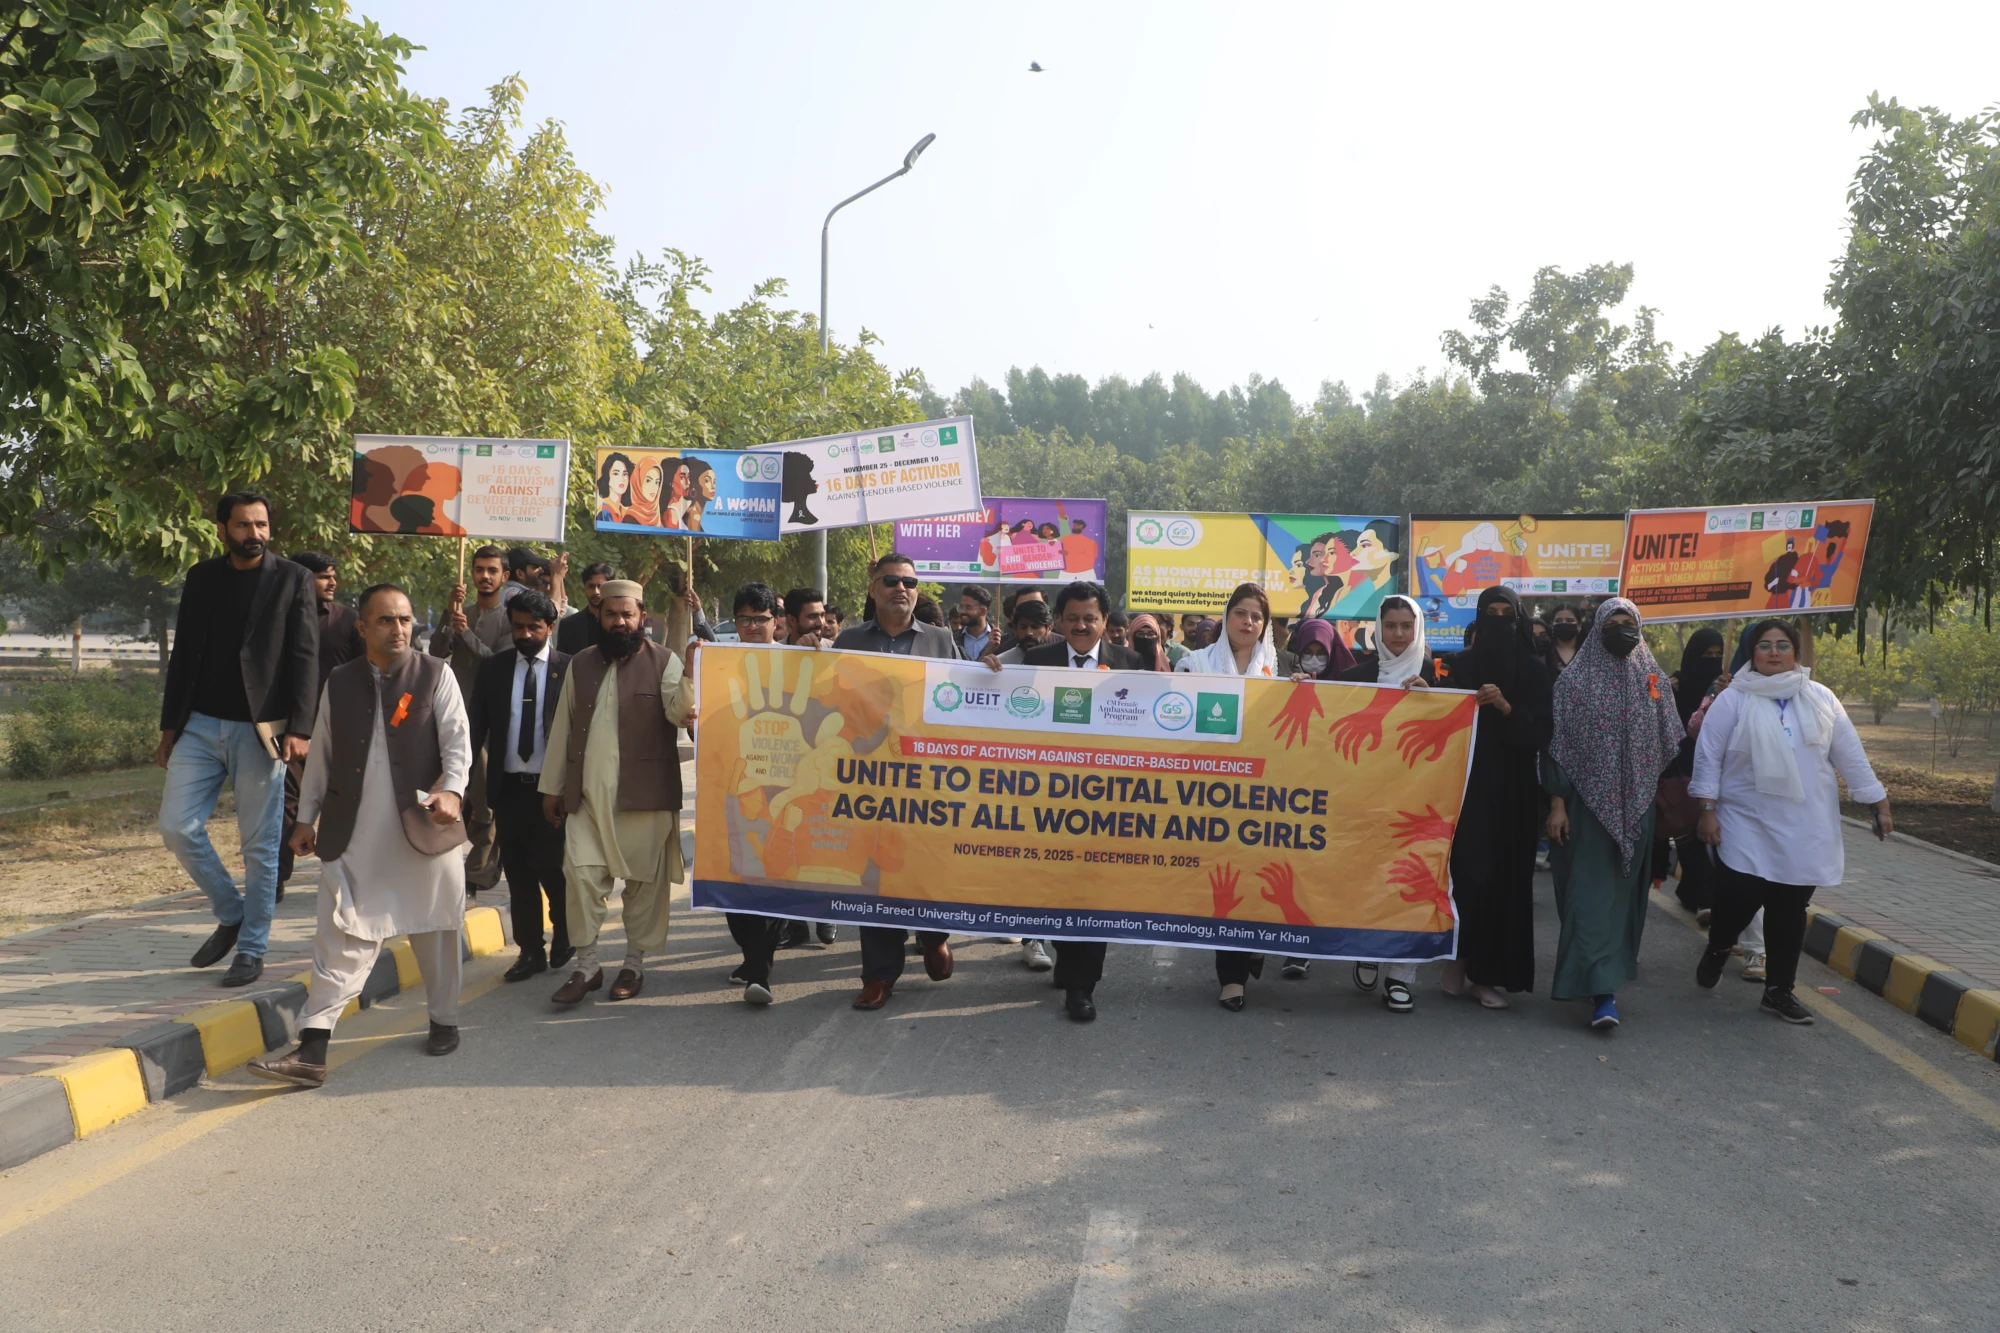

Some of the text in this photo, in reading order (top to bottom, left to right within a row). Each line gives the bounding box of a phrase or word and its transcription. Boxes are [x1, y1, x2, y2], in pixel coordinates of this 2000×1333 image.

[841, 445, 856, 453] UEIT
[492, 465, 541, 475] 16 DAYS
[844, 464, 878, 474] NOVEMBER
[894, 458, 929, 467] DECEMBER
[477, 474, 555, 486] OF ACTIVISM
[826, 462, 960, 492] 16 DAYS OF ACTIVISM
[489, 485, 541, 496] AGAINST
[826, 478, 963, 502] AGAINST GENDER-BASED VIOLENCE
[467, 495, 562, 507] GENDER-BASED
[714, 496, 775, 512] A WOMAN
[484, 505, 543, 516] VIOLENCE
[900, 524, 961, 538] WITH HER
[1633, 533, 1699, 560] UNITE!
[1001, 560, 1063, 572] BASED VIOLENCE
[1005, 555, 1020, 564] END
[1630, 559, 1734, 573] ACTIVISM TO END VIOLENCE
[1133, 566, 1282, 580] AS WOMEN STEP OUT
[1628, 570, 1733, 586] AGAINST WOMEN AND GIRLS
[1133, 576, 1151, 586] TO
[1154, 577, 1201, 589] STUDY
[1204, 579, 1236, 589] AND
[1168, 590, 1196, 599] quietly
[1132, 597, 1162, 605] wishing
[1186, 599, 1211, 607] safety
[965, 692, 1000, 705] UEIT
[1098, 705, 1146, 714] Ambassador
[1162, 703, 1182, 714] GS
[1104, 712, 1138, 721] Program
[754, 720, 789, 736] STOP
[752, 737, 800, 752] VIOLENCE
[913, 742, 1252, 774] 16 DAYS OF ACTIVISM AGAINST GENDER-BASED VIOLENCE
[836, 758, 1328, 816] UNITE TO END DIGITAL VIOLENCE
[832, 793, 966, 828] AGAINST
[970, 804, 1025, 832] ALL
[1034, 807, 1156, 839] WOMEN
[1162, 815, 1230, 842] AND
[1238, 820, 1327, 850] GIRLS
[953, 843, 1021, 858] NOVEMBER
[1023, 848, 1041, 861] 25,
[1044, 849, 1074, 861] 2025
[1084, 852, 1149, 865] DECEMBER
[1152, 855, 1167, 868] 10,
[1170, 856, 1200, 867] 2025
[831, 900, 1310, 944] Khwaja Fareed University of Engineering & Information Technology, Rahim Yar Khan
